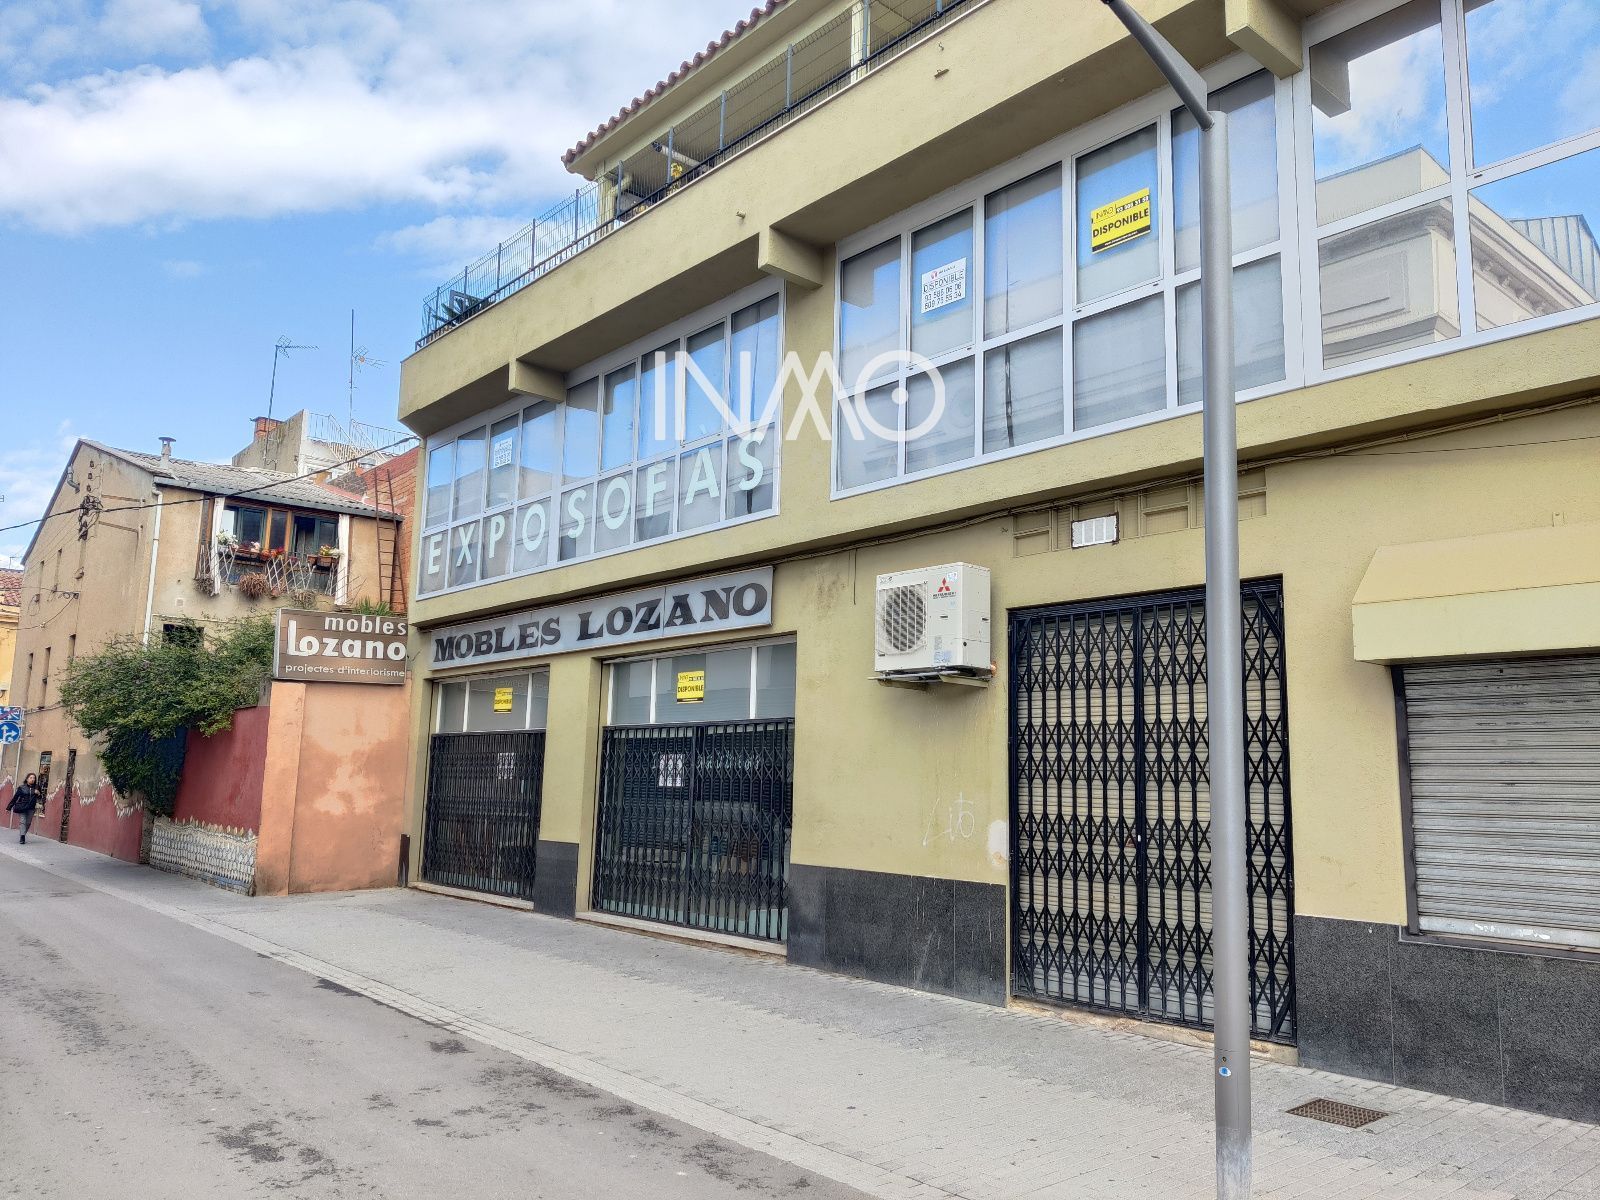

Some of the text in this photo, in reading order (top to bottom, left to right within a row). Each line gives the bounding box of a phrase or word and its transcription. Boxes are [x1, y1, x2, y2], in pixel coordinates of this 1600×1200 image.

[1092, 208, 1149, 238] DISPONIBLE
[923, 269, 965, 294] DISPONIBLE
[324, 615, 407, 636] mobles
[433, 582, 768, 663] MOBLES LOZANO
[286, 619, 406, 661] Lozano
[285, 663, 405, 677] projectes d'interiorisme
